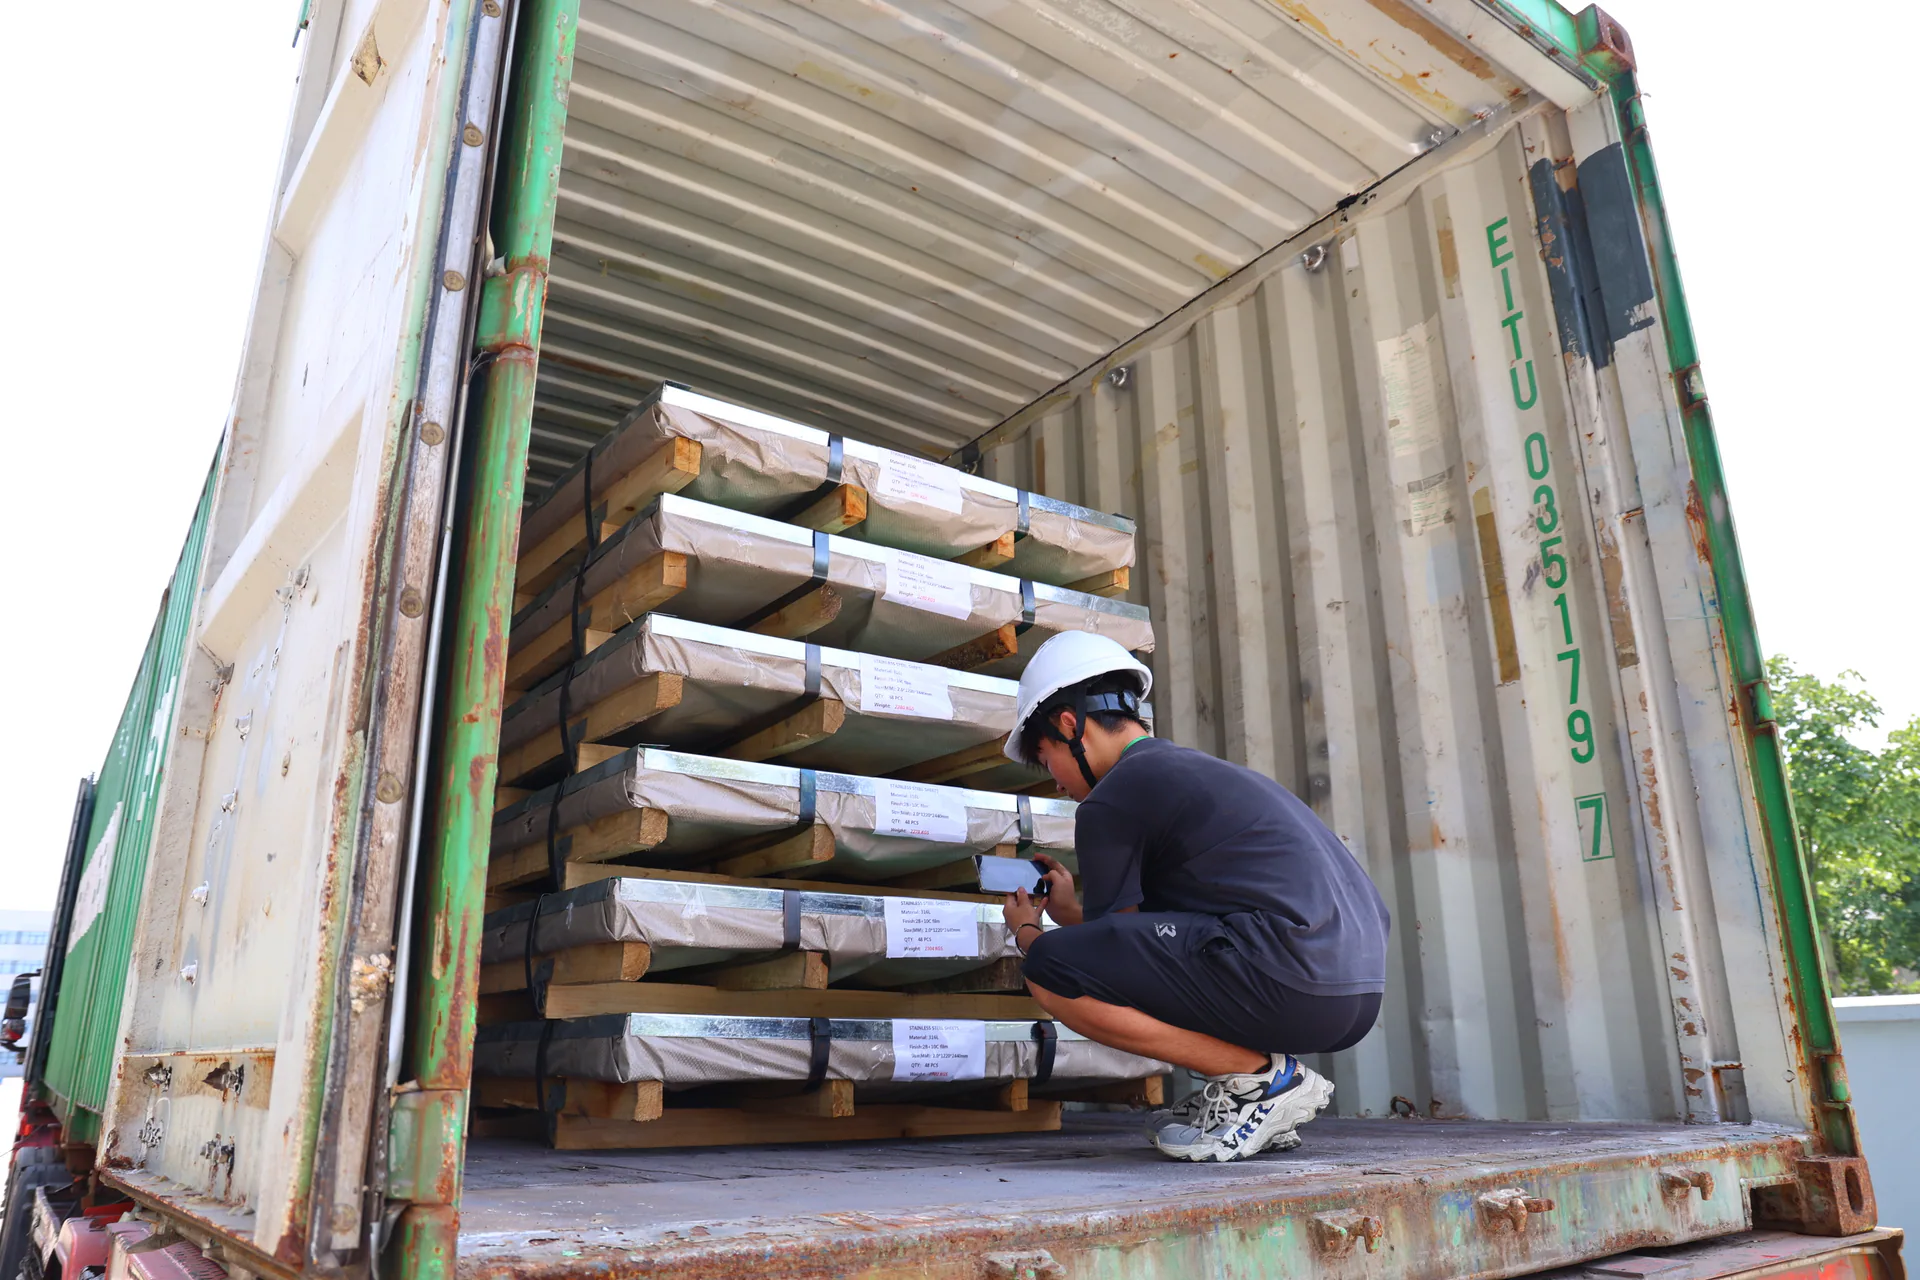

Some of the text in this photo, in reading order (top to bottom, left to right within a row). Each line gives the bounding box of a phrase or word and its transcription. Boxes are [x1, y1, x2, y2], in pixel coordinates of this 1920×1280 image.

[1486, 216, 1603, 857] EITU 035179 7
